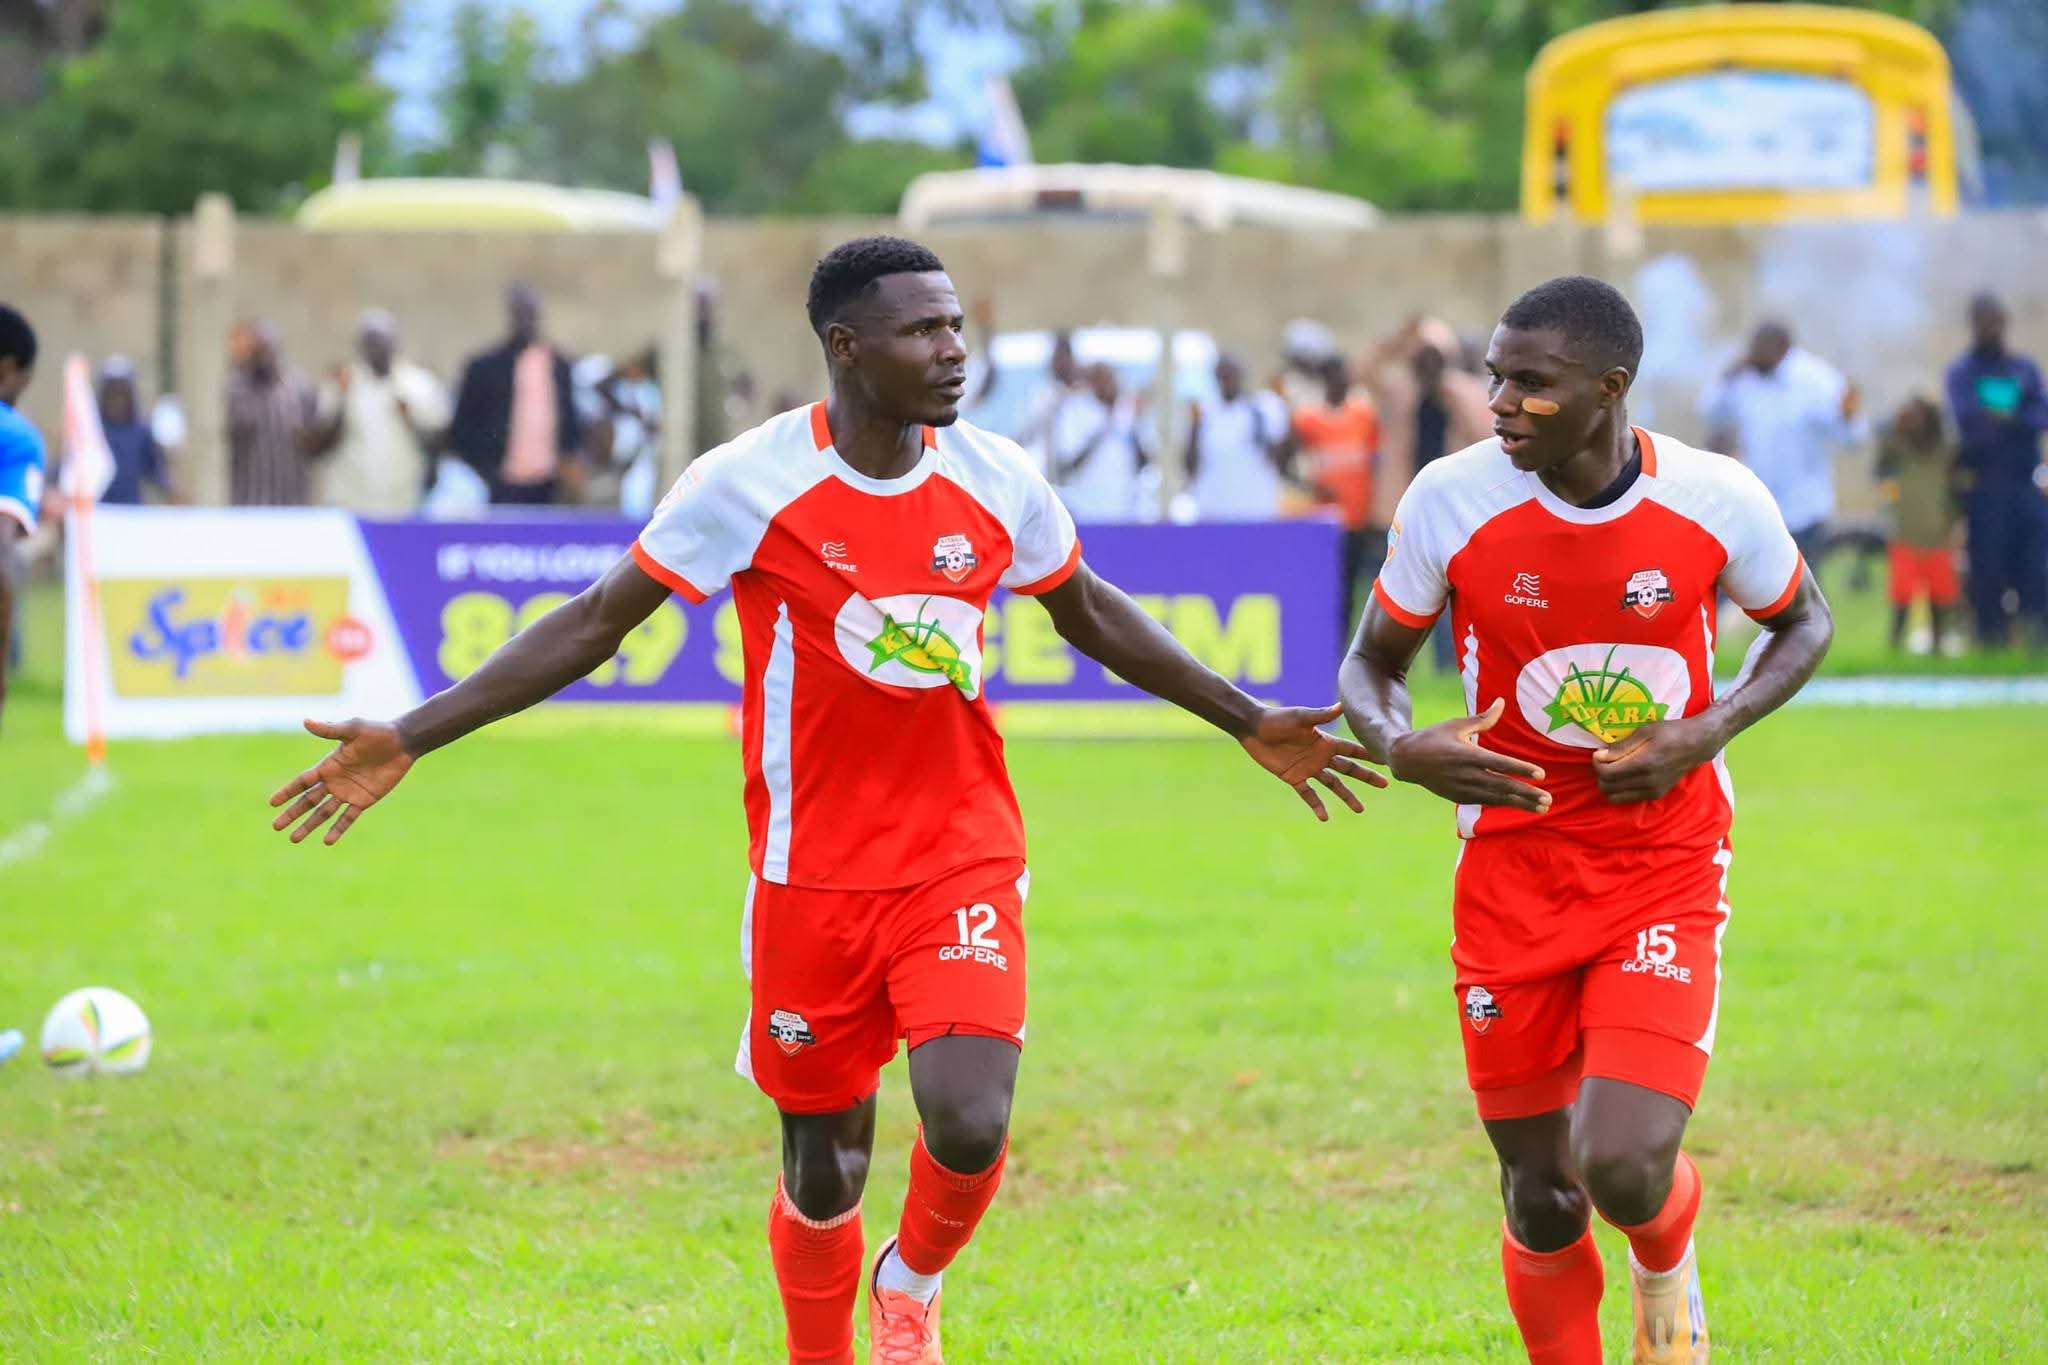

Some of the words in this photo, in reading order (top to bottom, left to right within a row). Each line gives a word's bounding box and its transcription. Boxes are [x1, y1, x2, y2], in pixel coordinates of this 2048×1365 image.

[1504, 594, 1549, 609] GOFERE
[951, 903, 1000, 950] 12
[1636, 923, 1677, 965] 15
[938, 945, 1008, 972] GOFERE
[1621, 959, 1692, 984] GOFERE
